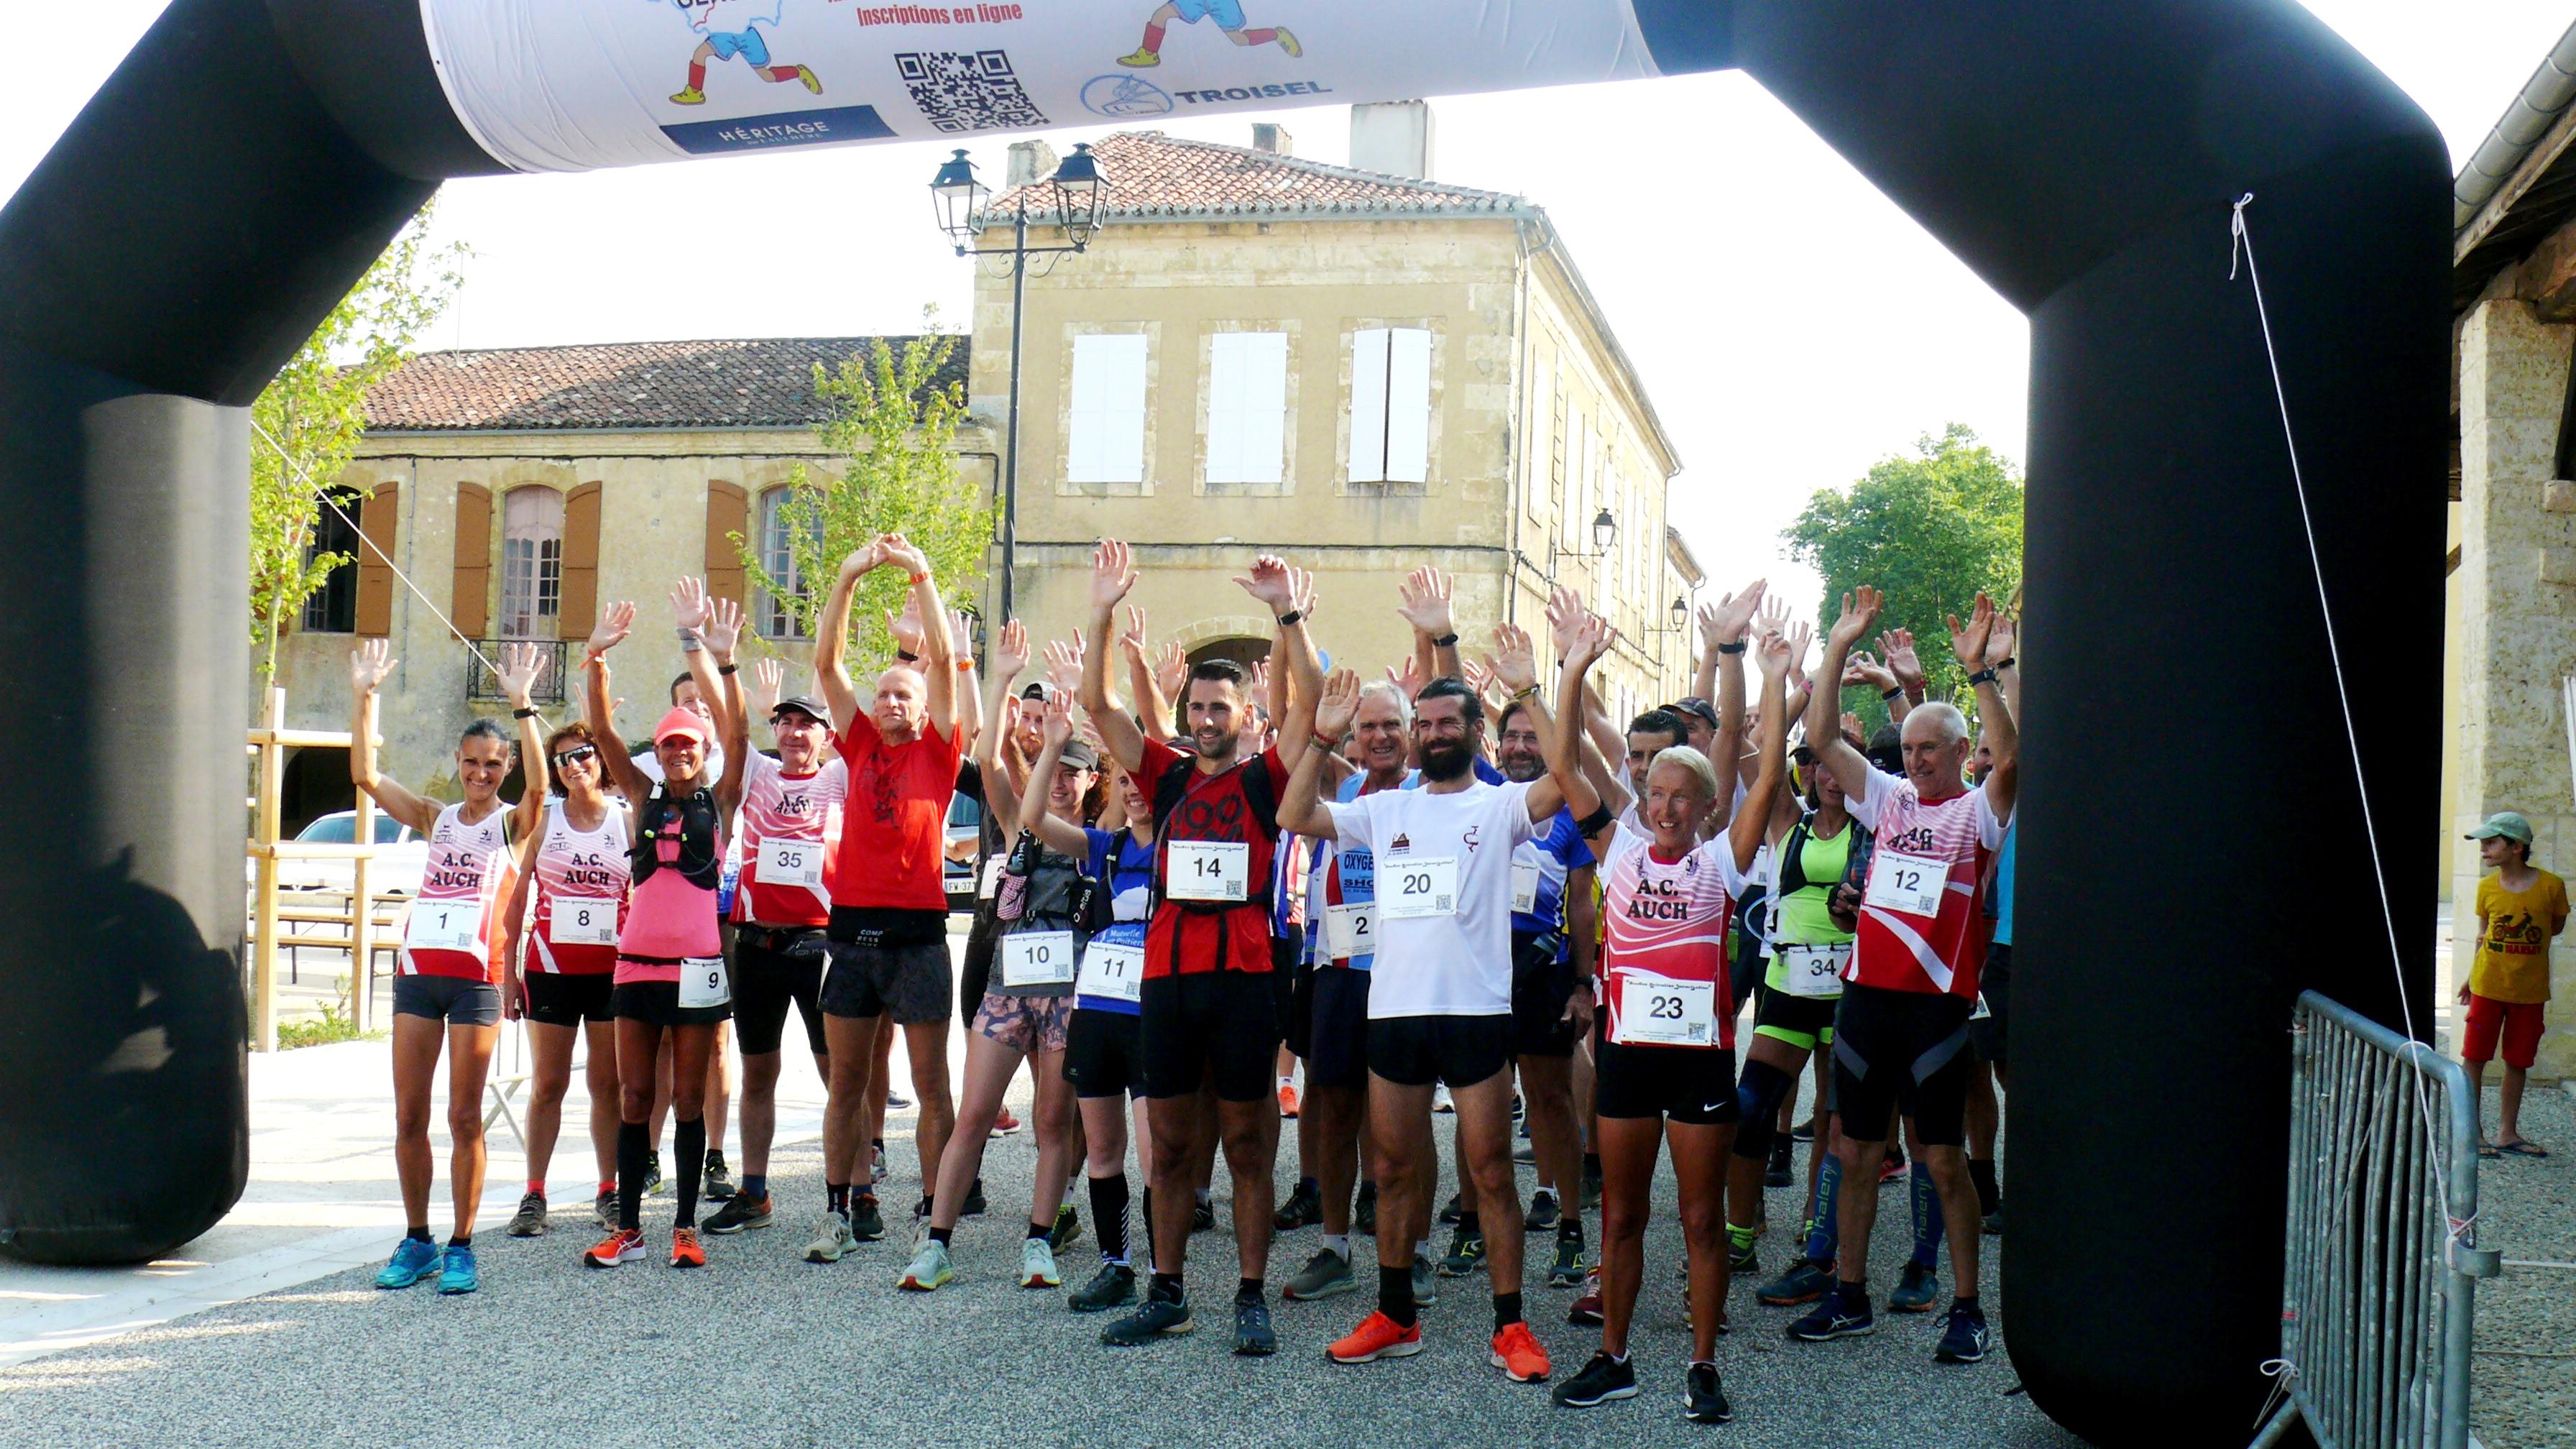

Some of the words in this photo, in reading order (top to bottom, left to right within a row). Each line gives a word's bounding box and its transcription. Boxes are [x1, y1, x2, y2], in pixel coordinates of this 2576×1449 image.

[857, 4, 950, 27] Inscriptions
[952, 9, 975, 24] en
[976, 4, 1023, 24] ligne
[1174, 81, 1332, 104] TROISEL
[719, 121, 829, 141] HÉRITAGE
[441, 852, 474, 867] A.C.
[571, 853, 603, 867] A.C.
[778, 851, 802, 868] 35
[1194, 857, 1221, 877] 14
[431, 872, 481, 887] AUCH
[564, 870, 610, 885] AUCH
[1403, 874, 1431, 894] 20
[1895, 870, 1920, 891] 12
[1636, 878, 1678, 896] A.C.
[578, 911, 590, 926] 8
[1626, 900, 1688, 919] AUCH
[439, 913, 448, 929] 1
[1025, 946, 1049, 964] 10
[1104, 958, 1124, 978] 11
[1811, 959, 1836, 976] 34
[709, 972, 718, 989] 9
[1650, 996, 1683, 1019] 23
